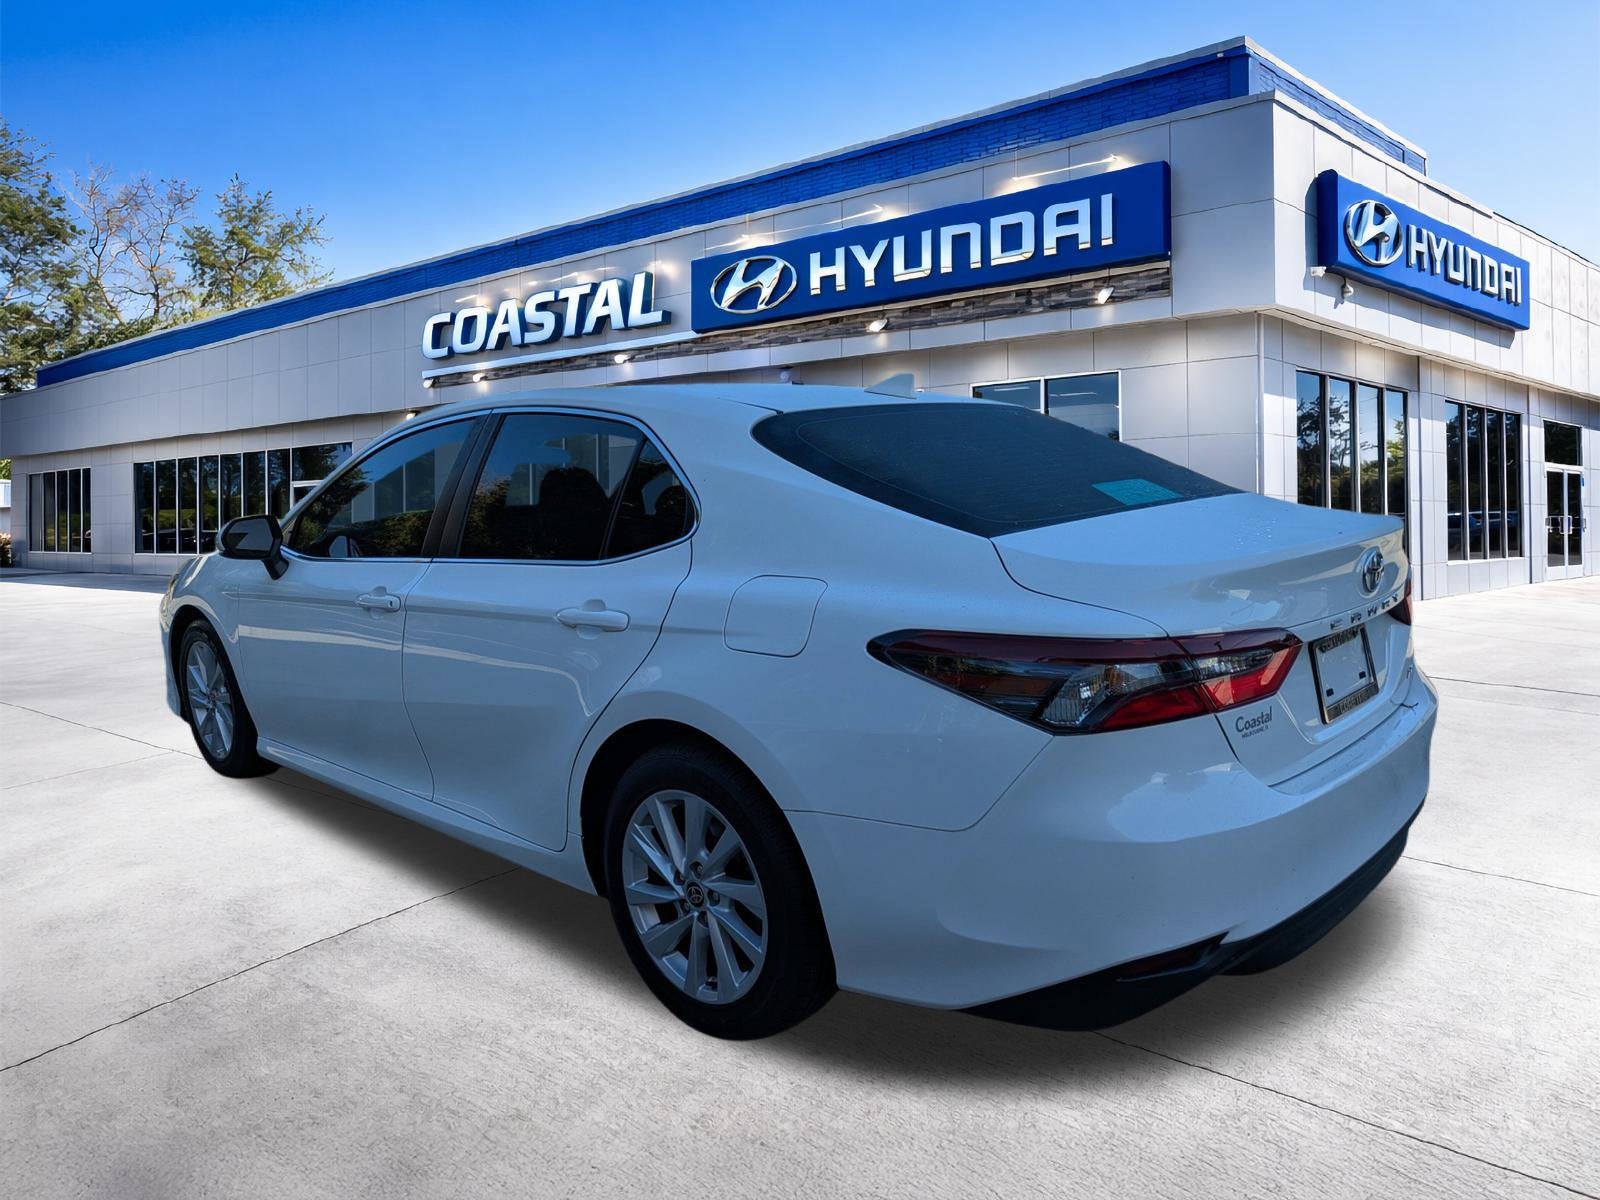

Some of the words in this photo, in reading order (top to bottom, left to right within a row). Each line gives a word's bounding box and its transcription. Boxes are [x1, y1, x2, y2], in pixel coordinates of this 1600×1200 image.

[809, 193, 1113, 296] HYUNDAI
[1406, 224, 1522, 306] HYUNDAI
[422, 271, 665, 360] COASTAL
[1235, 706, 1272, 733] Coastal
